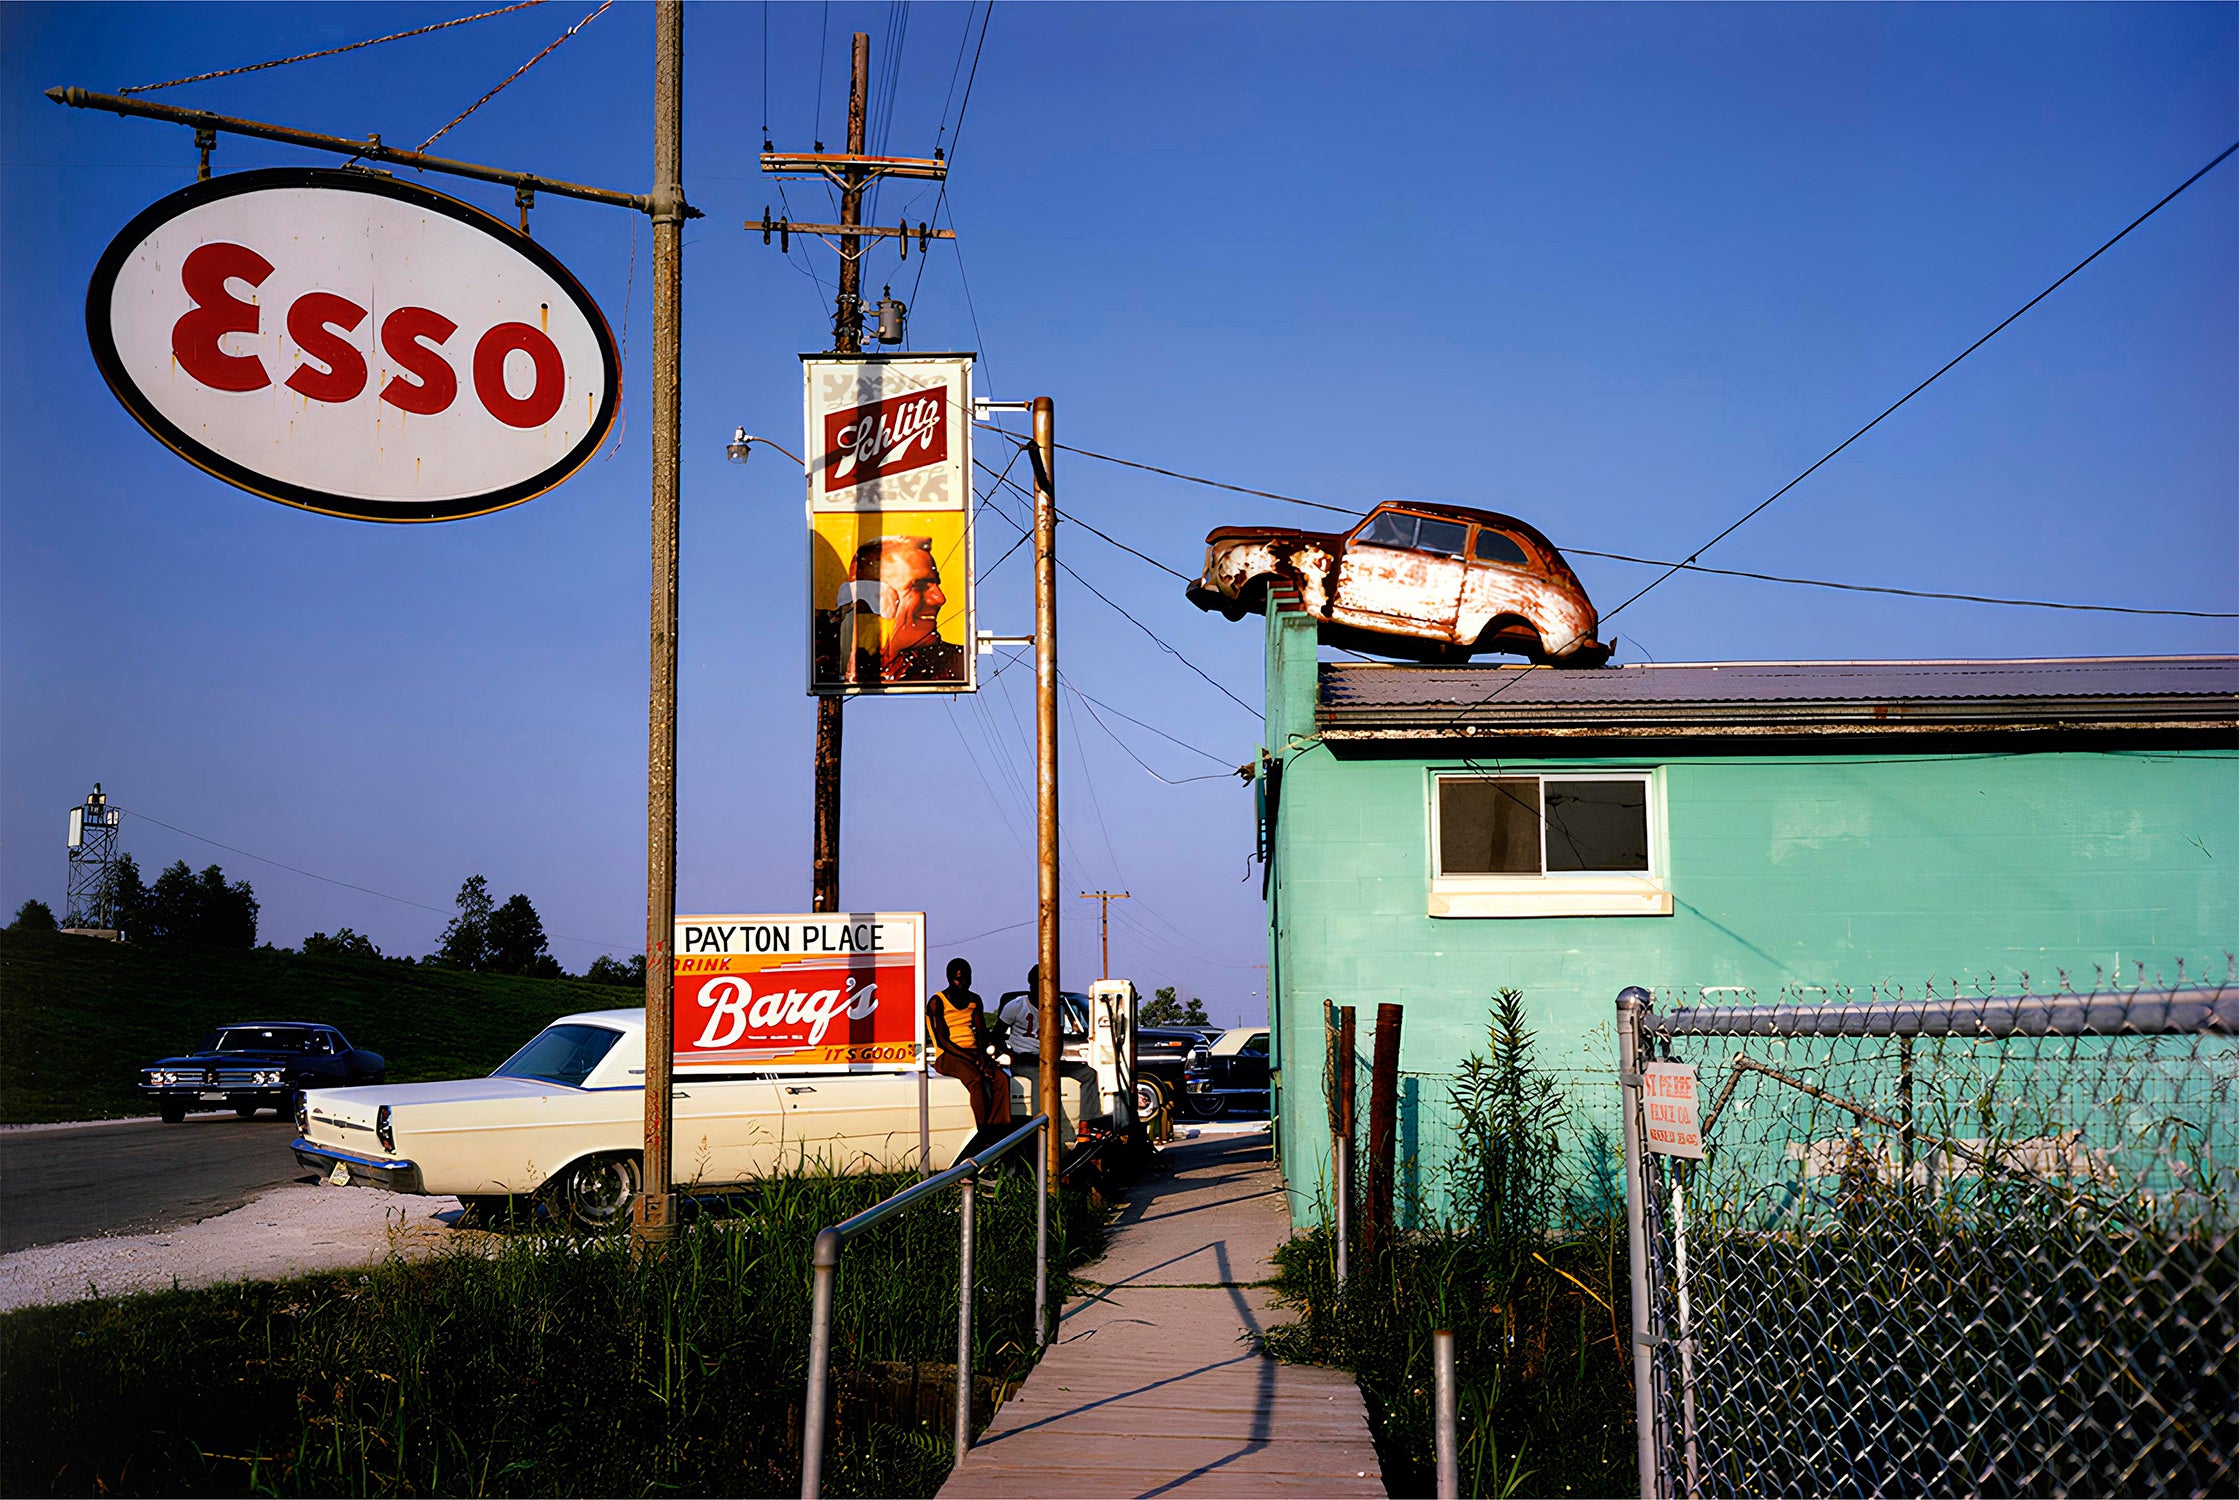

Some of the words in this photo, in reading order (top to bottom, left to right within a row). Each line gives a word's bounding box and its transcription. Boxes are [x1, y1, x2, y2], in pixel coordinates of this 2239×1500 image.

[833, 396, 942, 479] Schlitz
[685, 926, 790, 952] PAYTON
[803, 924, 884, 951] PLACE
[692, 976, 879, 1048] Barq's
